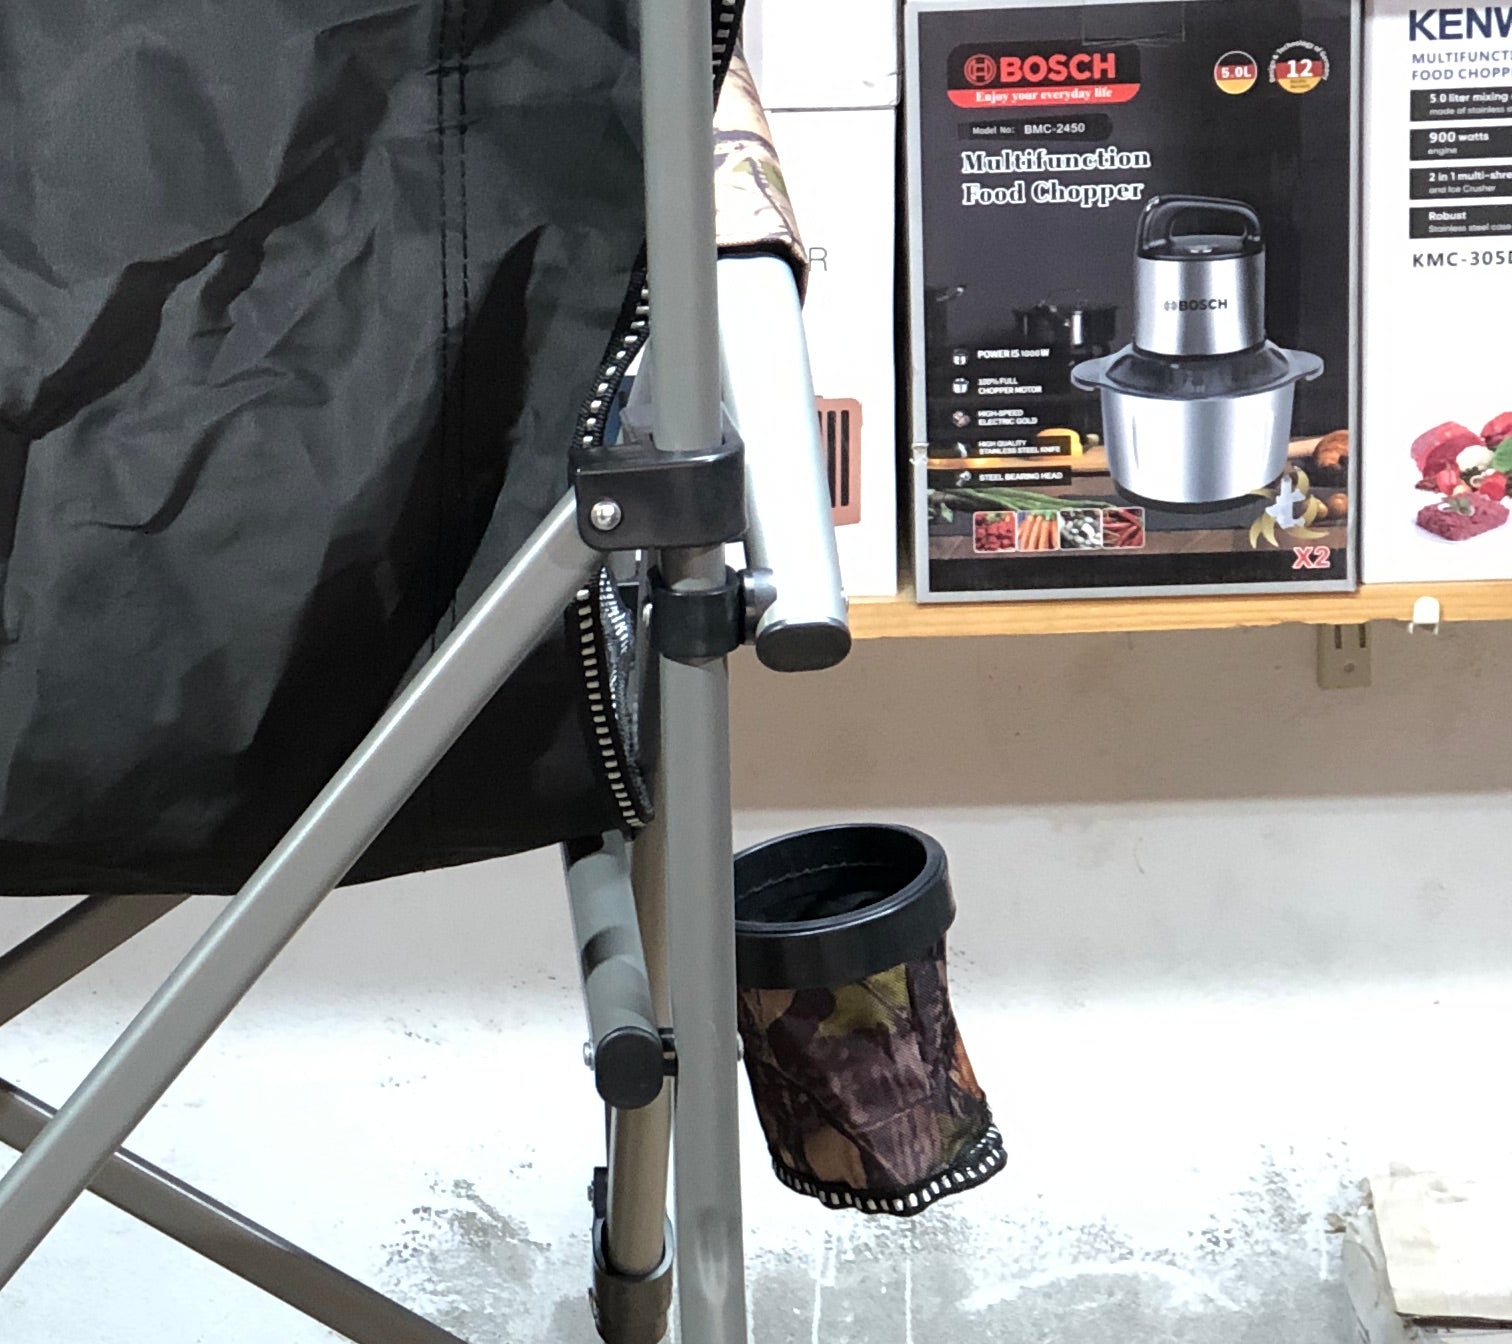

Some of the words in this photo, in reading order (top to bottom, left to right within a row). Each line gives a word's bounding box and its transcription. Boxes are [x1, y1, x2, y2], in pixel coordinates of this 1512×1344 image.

[999, 53, 1116, 82] BOSCH
[1221, 66, 1251, 78] 5.0L
[1286, 59, 1313, 78] 12
[1412, 69, 1454, 81] FOOD
[976, 91, 1008, 103] Enjoy
[1012, 90, 1037, 102] your
[1040, 88, 1091, 101] everyday
[1094, 86, 1112, 98] life
[1448, 92, 1469, 102] liter
[1472, 92, 1508, 104] mixing
[1429, 108, 1454, 116] made
[972, 126, 997, 135] Model
[1024, 123, 1086, 135] BMC-2450
[1429, 132, 1456, 143] 900
[1458, 131, 1489, 142] watts
[1427, 146, 1458, 157] engine
[961, 145, 1152, 174] Multifunction
[1429, 172, 1436, 182] 2
[1438, 172, 1448, 182] in
[1450, 172, 1456, 181] 1
[962, 180, 1026, 206] Food
[1031, 179, 1144, 207] Chopper
[1429, 185, 1446, 194] and
[1463, 184, 1496, 193] Crusher
[1429, 211, 1467, 221] Robust
[1179, 299, 1228, 311] BOSCH
[977, 349, 1009, 359] POWER
[1292, 546, 1331, 569] X2
